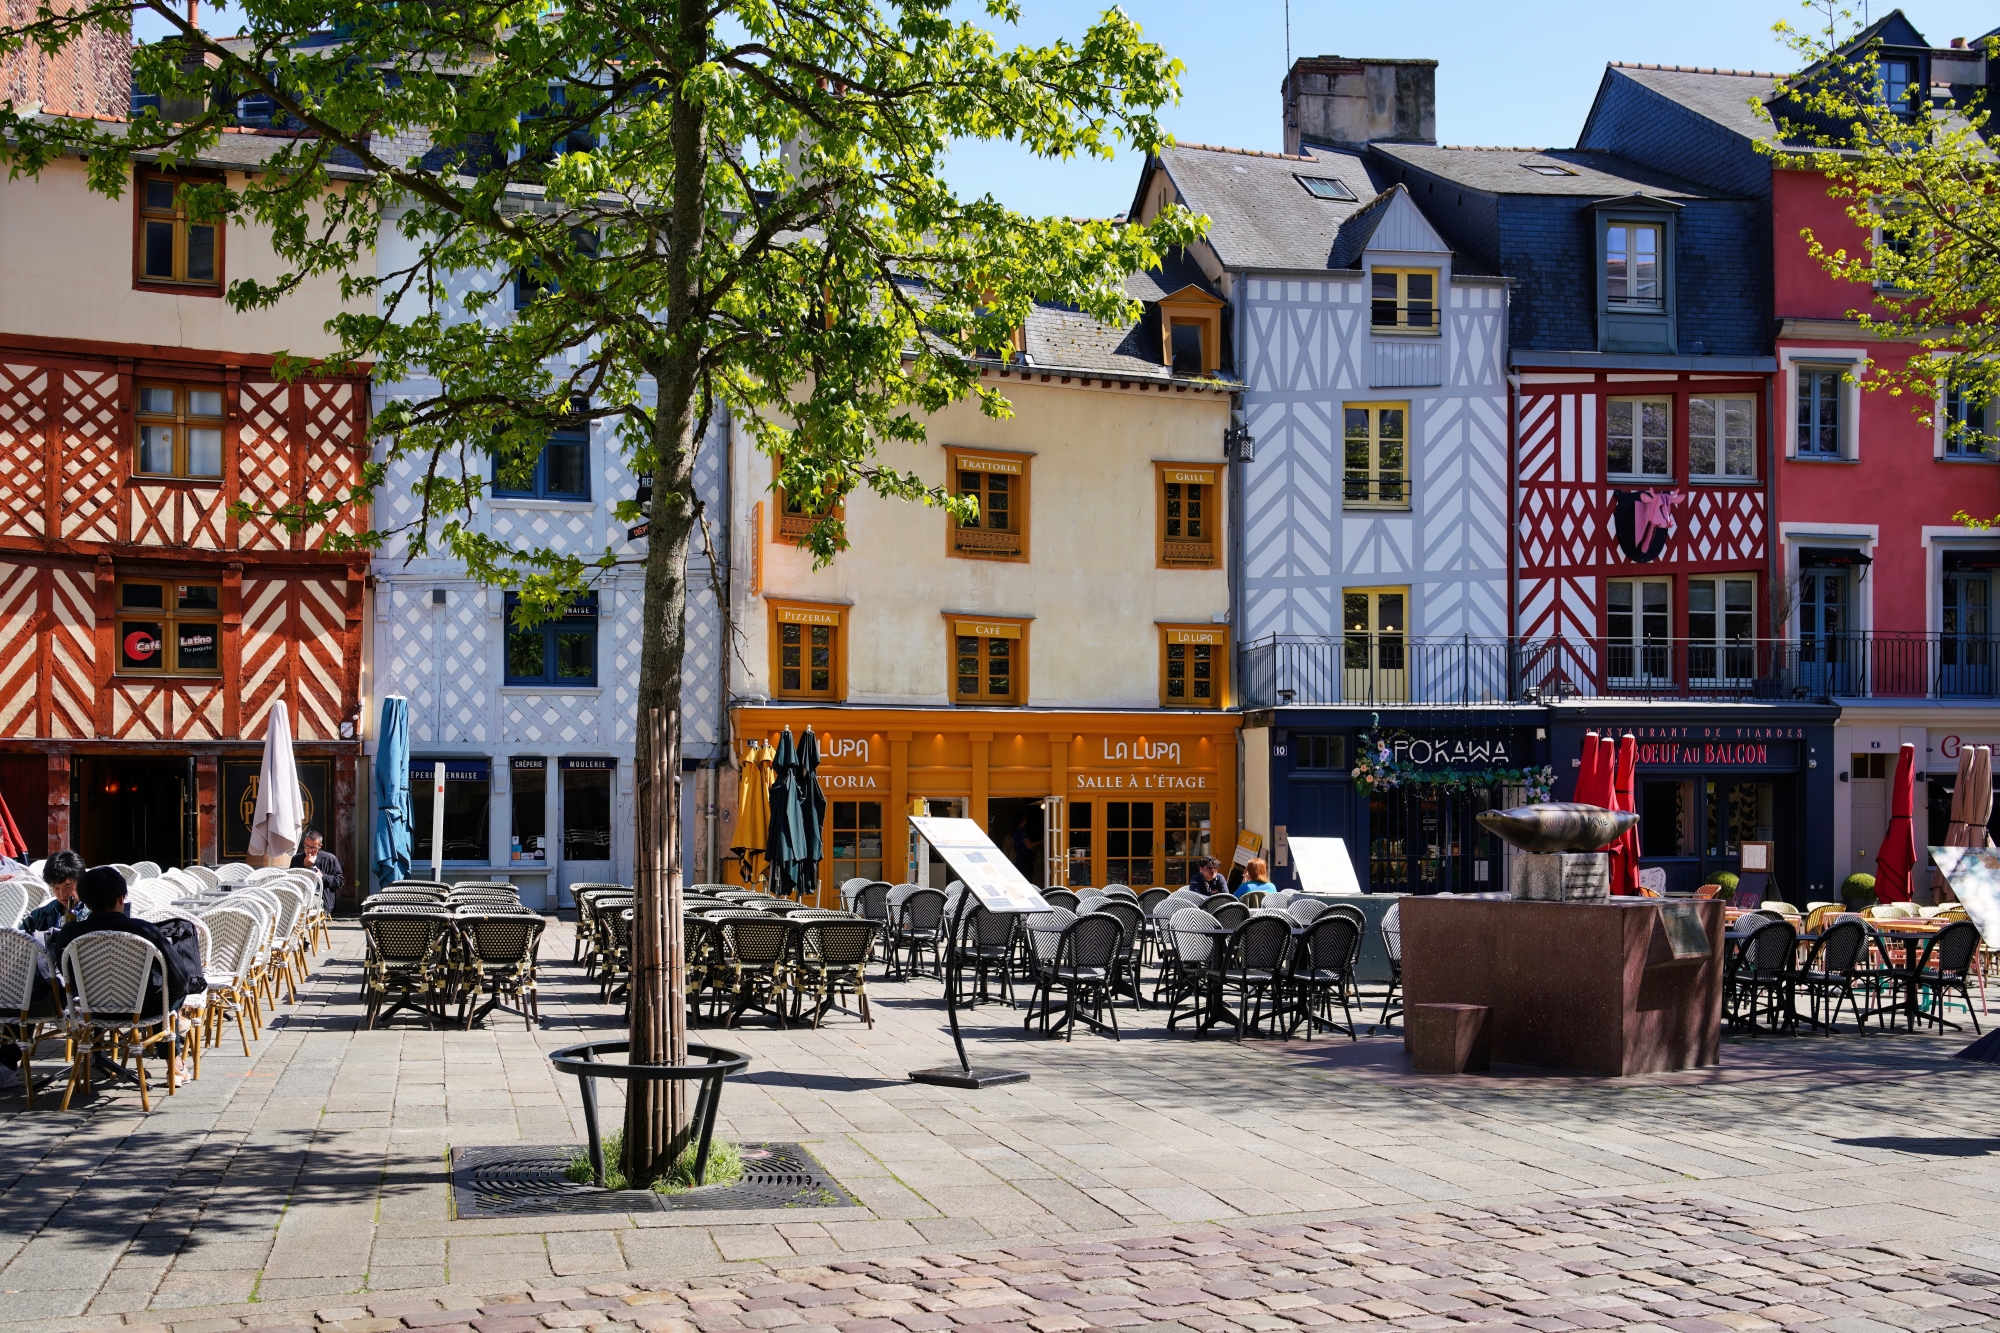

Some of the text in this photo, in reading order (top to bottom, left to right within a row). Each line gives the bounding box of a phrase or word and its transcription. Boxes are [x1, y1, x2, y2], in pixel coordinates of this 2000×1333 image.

[961, 459, 1018, 472] TRATTORIA
[1175, 472, 1205, 482] GRILL
[785, 611, 831, 623] PIZZERIA
[975, 625, 1001, 635] CAFÉ
[180, 634, 213, 647] Latino
[135, 640, 161, 653] Café
[1704, 727, 1721, 738] DE
[1736, 727, 1803, 738] VIANDES
[1276, 746, 1286, 755] 10
[1393, 739, 1510, 764] POKAWA
[1683, 747, 1700, 764] AU
[1704, 743, 1767, 764] BALCON
[514, 759, 543, 768] CRÊPERIE
[569, 760, 606, 768] MOULERIE
[446, 770, 478, 780] ENNAISE
[1077, 774, 1206, 788] SALLE À L'ÉTAGE
